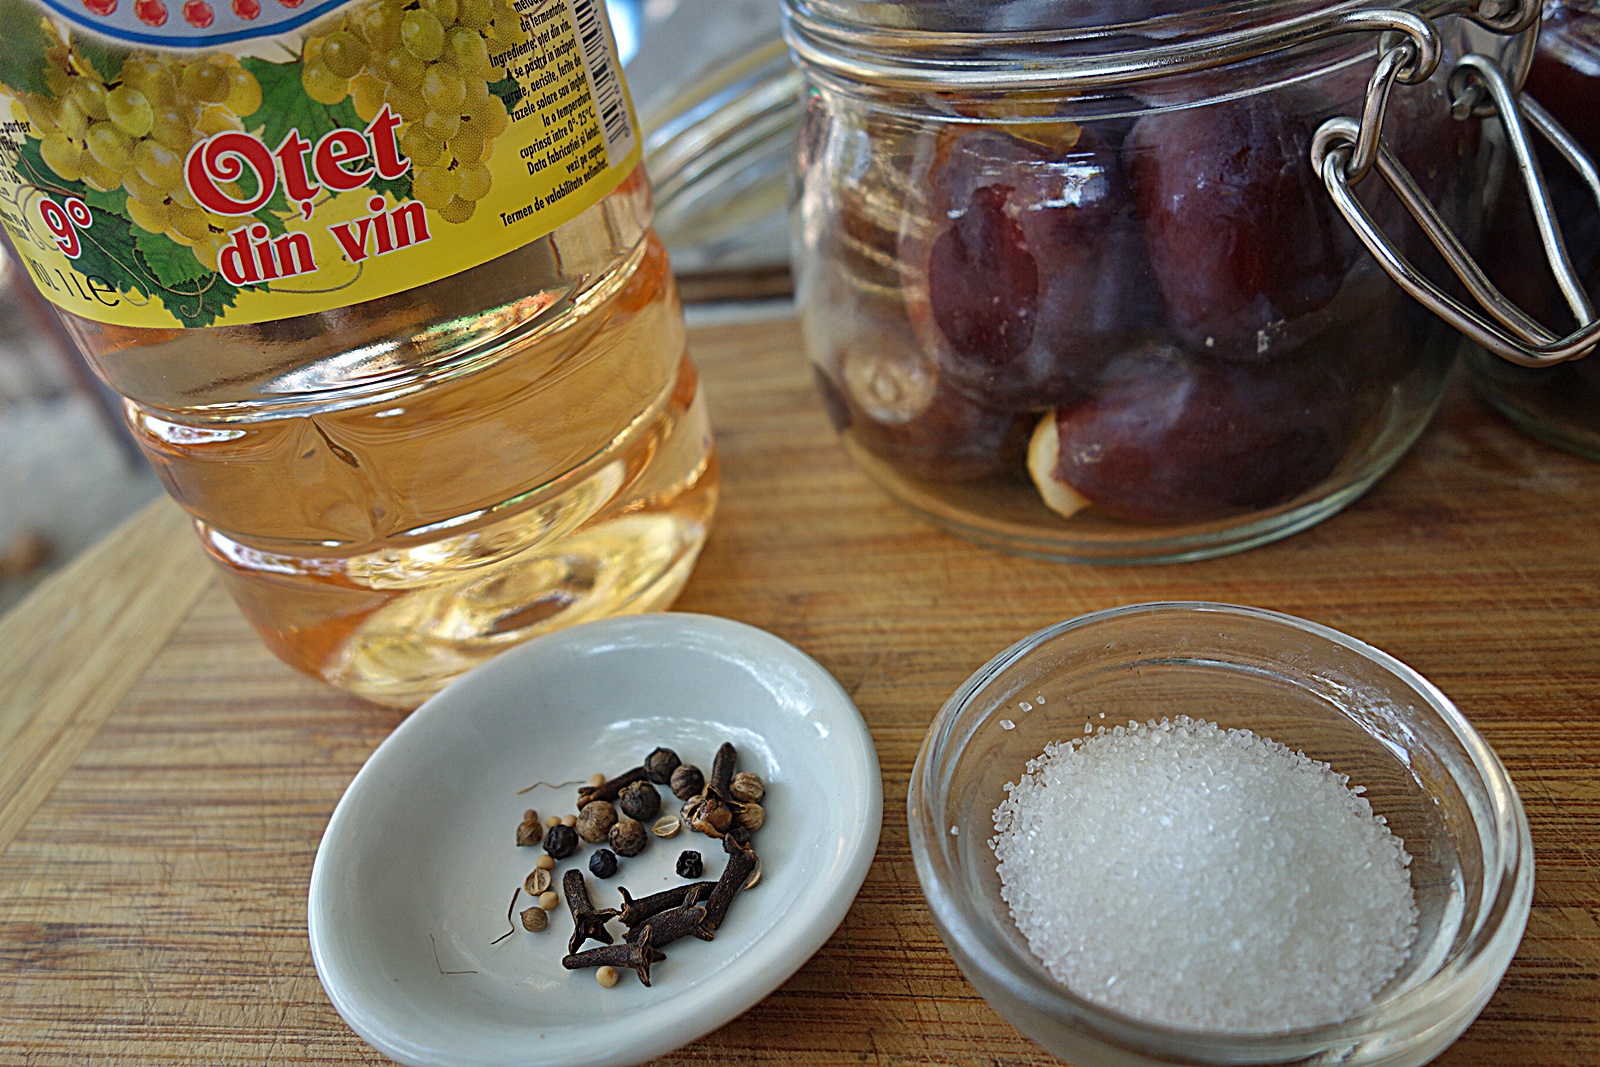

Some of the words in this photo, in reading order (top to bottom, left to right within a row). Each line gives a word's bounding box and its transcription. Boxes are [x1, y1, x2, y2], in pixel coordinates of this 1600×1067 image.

[488, 38, 538, 68] Ingrediente:
[551, 23, 560, 37] din
[560, 19, 572, 33] vin.
[520, 17, 531, 32] de
[501, 86, 530, 107] curate,
[530, 71, 560, 93] aerisite,
[557, 59, 575, 78] ferite
[573, 52, 582, 68] de
[506, 68, 514, 82] A
[514, 67, 524, 79] se
[524, 54, 548, 78] păstra
[510, 100, 536, 123] razele
[536, 92, 558, 111] solare
[558, 85, 569, 98] sau
[541, 113, 551, 128] la
[551, 112, 557, 123] o
[556, 88, 592, 116] temperatură
[185, 102, 411, 222] Oțet
[519, 133, 553, 160] cuprinsă
[550, 128, 569, 143] între
[527, 157, 547, 175] Data
[585, 122, 601, 143] lotul:
[565, 156, 581, 174] vezi
[580, 152, 588, 170] pe
[587, 143, 605, 161] capac.
[499, 204, 534, 227] Termen
[534, 196, 545, 212] de
[544, 176, 584, 206] valabilitate
[583, 158, 609, 183] nelimitat.
[217, 222, 319, 287] din
[326, 194, 432, 263] vin
